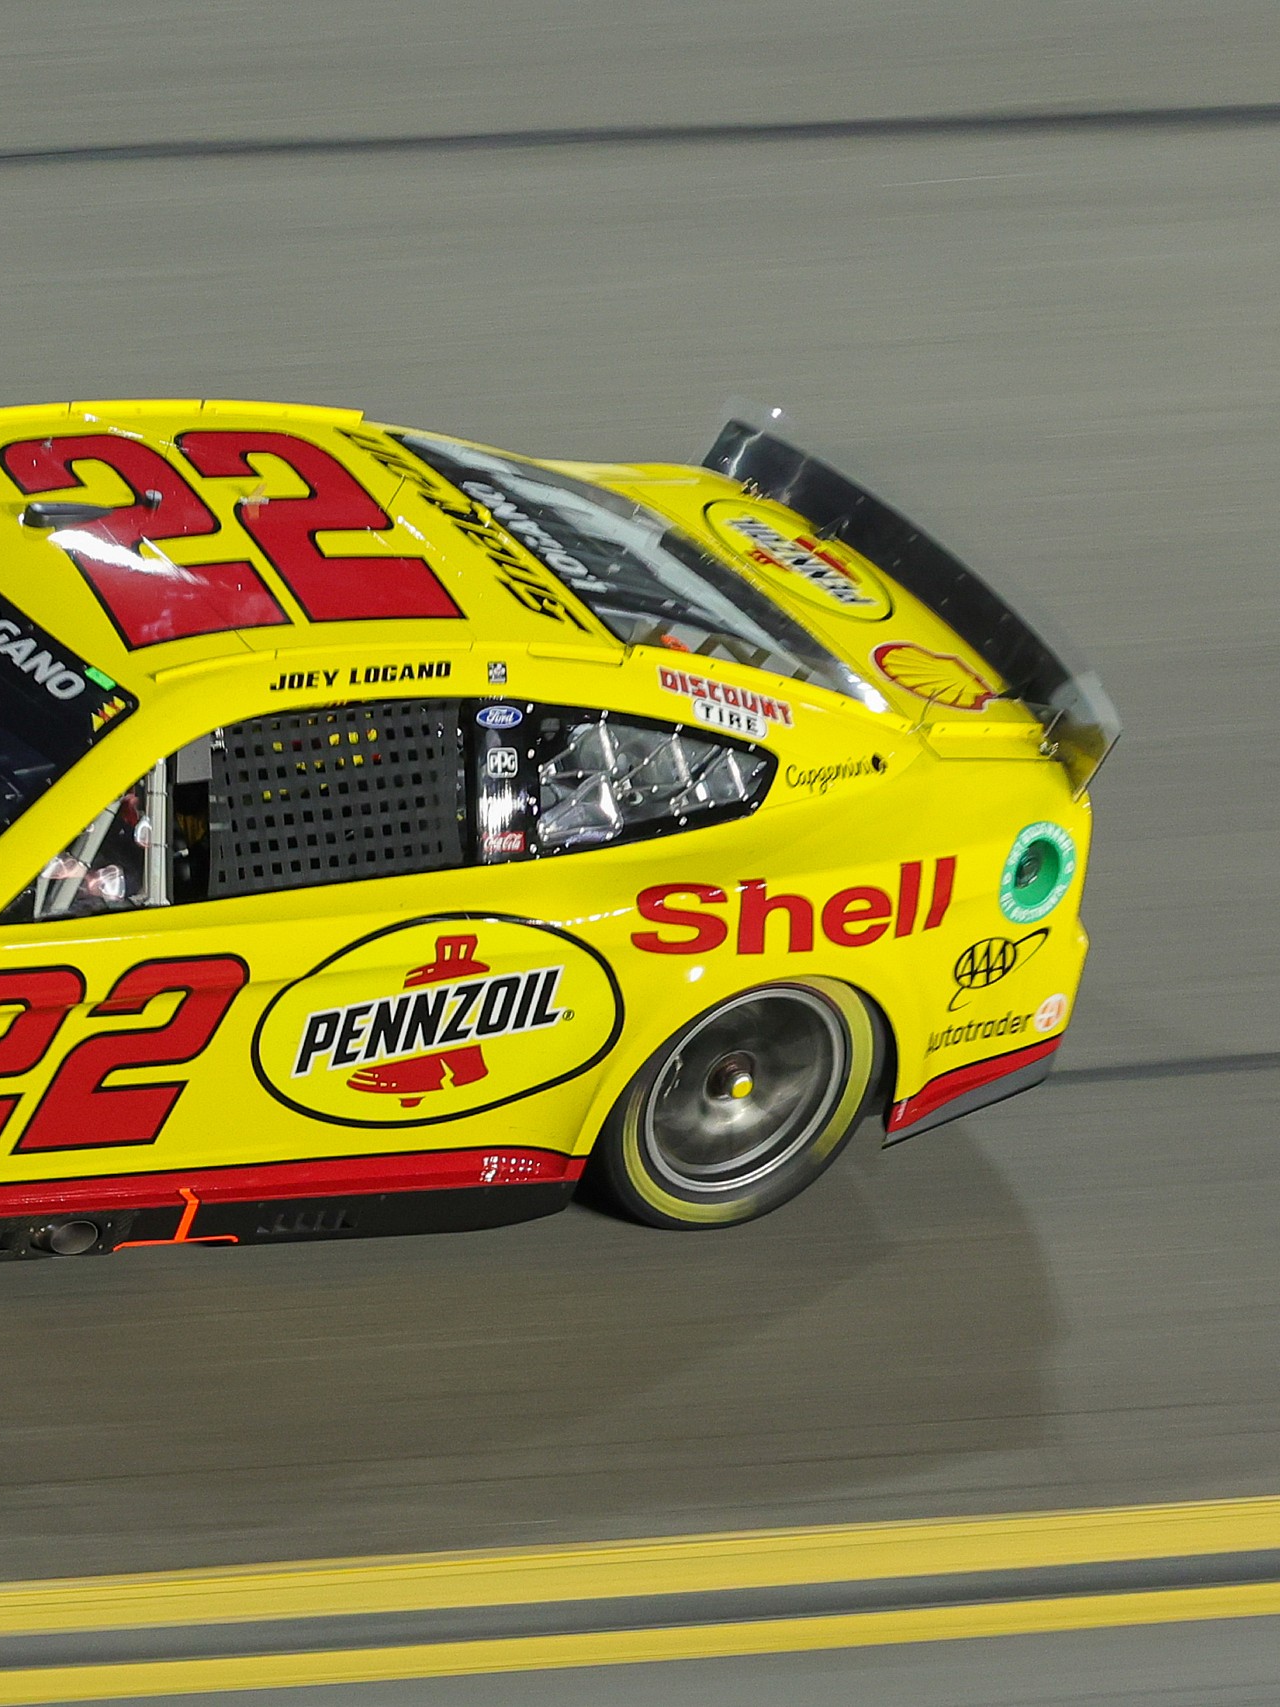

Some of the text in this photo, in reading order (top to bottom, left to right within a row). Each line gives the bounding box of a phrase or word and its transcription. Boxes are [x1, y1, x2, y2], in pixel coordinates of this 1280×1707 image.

[270, 660, 452, 691] JOEY LOGANO
[485, 707, 516, 725] Ford
[658, 665, 794, 728] DISCOUNT
[700, 702, 760, 736] TIRE
[489, 750, 516, 775] PPG
[785, 754, 872, 795] Capgemini
[629, 854, 958, 956] Shell
[956, 938, 1015, 988] AAA
[293, 966, 565, 1076] PENNZOIL
